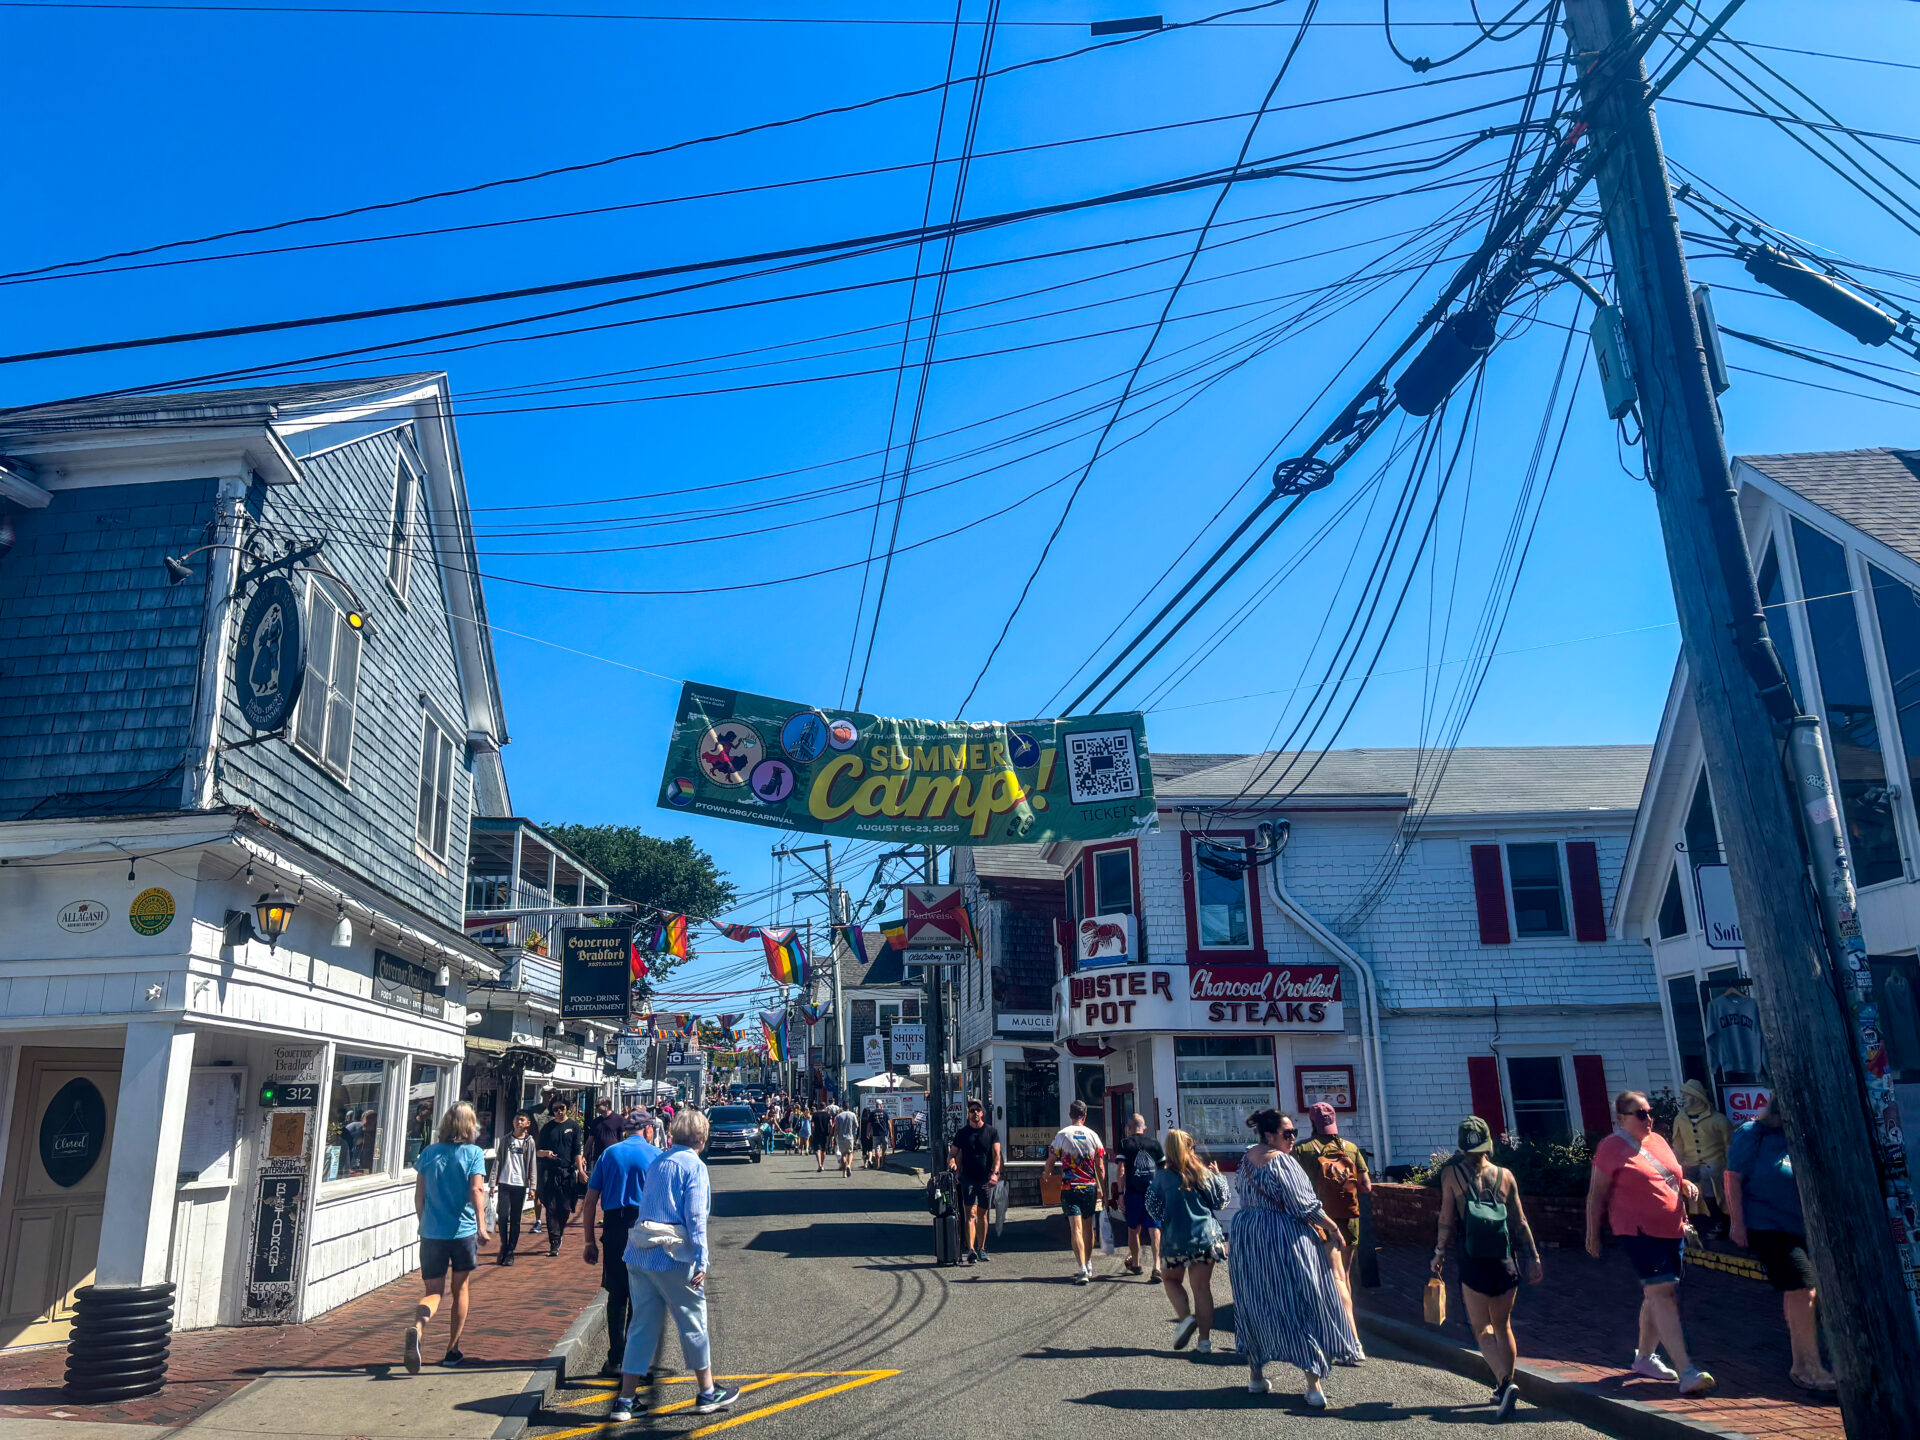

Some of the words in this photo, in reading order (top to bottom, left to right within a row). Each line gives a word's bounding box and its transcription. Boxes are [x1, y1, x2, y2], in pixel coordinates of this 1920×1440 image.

[862, 732, 884, 740] 47TH
[870, 742, 1007, 772] SUMMER
[695, 802, 796, 825] PTOWN.ORG/CARNIVAL
[1080, 805, 1138, 822] TICKETS
[856, 824, 899, 832] AUGUST
[900, 825, 931, 834] 16-23,
[932, 824, 960, 832] 2025
[62, 911, 104, 923] ALLAGASH
[908, 909, 955, 920] Budweis
[568, 936, 621, 949] Governor
[577, 948, 625, 961] Bradford
[945, 953, 961, 961] TAP
[1189, 968, 1272, 1001] Charcoal
[1274, 971, 1339, 1000] Broiled
[380, 990, 392, 1000] FOOD
[564, 1003, 625, 1012] ENTERTAINMENT
[1085, 1000, 1136, 1026] POT
[1208, 1002, 1326, 1023] STEAKS
[1719, 1013, 1739, 1029] CAPE
[1741, 1014, 1753, 1031] COD
[893, 1034, 924, 1043] SHIRTS
[276, 1047, 313, 1058] Governor
[619, 1046, 646, 1054] Tattoo
[895, 1052, 922, 1061] STUFF
[276, 1060, 314, 1071] Bradford
[286, 1087, 312, 1100] 312
[1241, 1097, 1270, 1105] DINING
[1729, 1093, 1768, 1110] GIA
[55, 1136, 86, 1150] Closed
